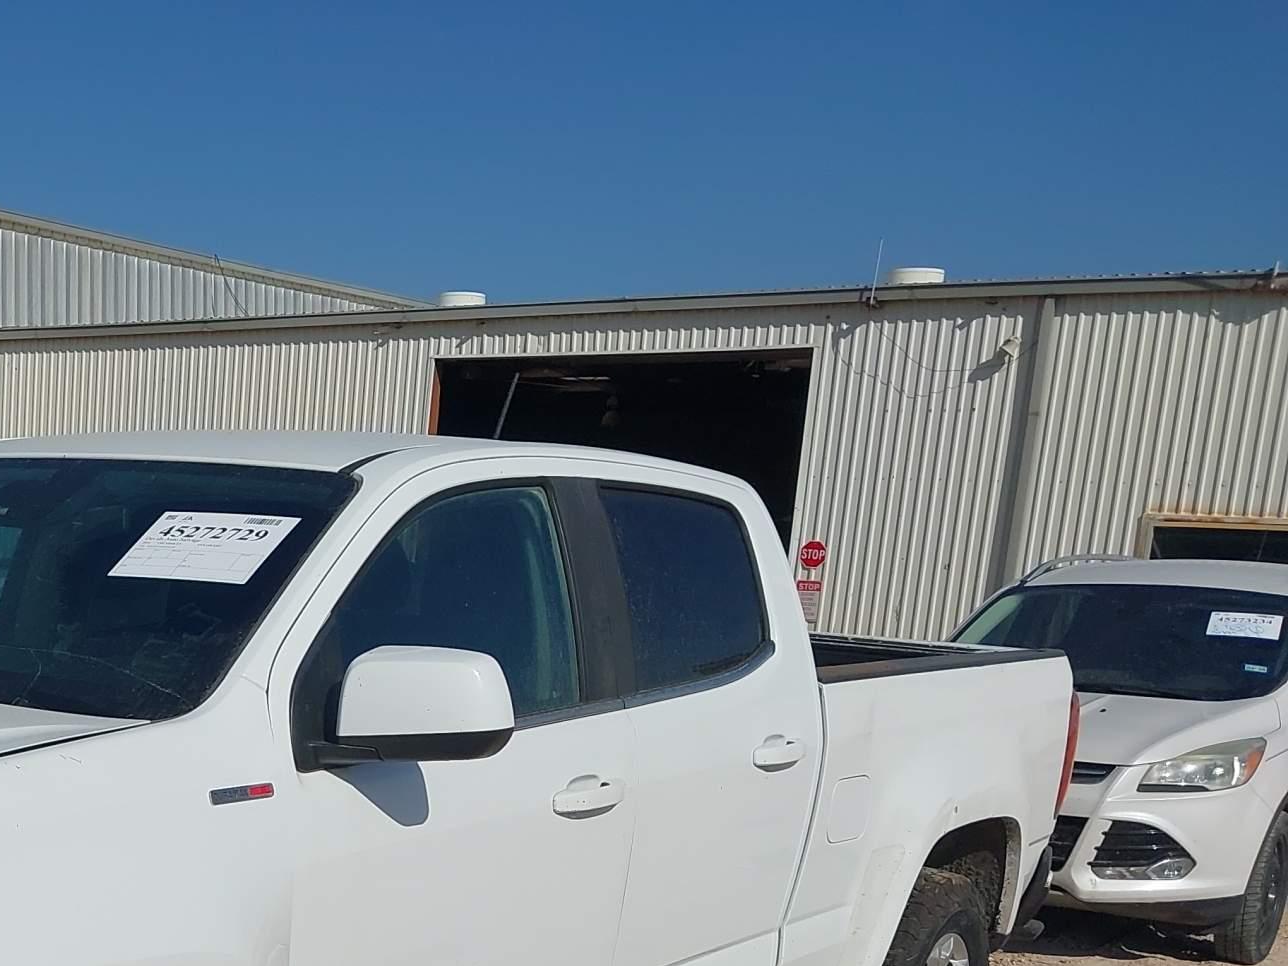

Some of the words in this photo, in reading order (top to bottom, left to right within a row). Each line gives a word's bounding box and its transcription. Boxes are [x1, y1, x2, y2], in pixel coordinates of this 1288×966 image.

[159, 525, 268, 541] 45272729
[801, 548, 826, 560] STOP
[798, 583, 821, 591] STOP
